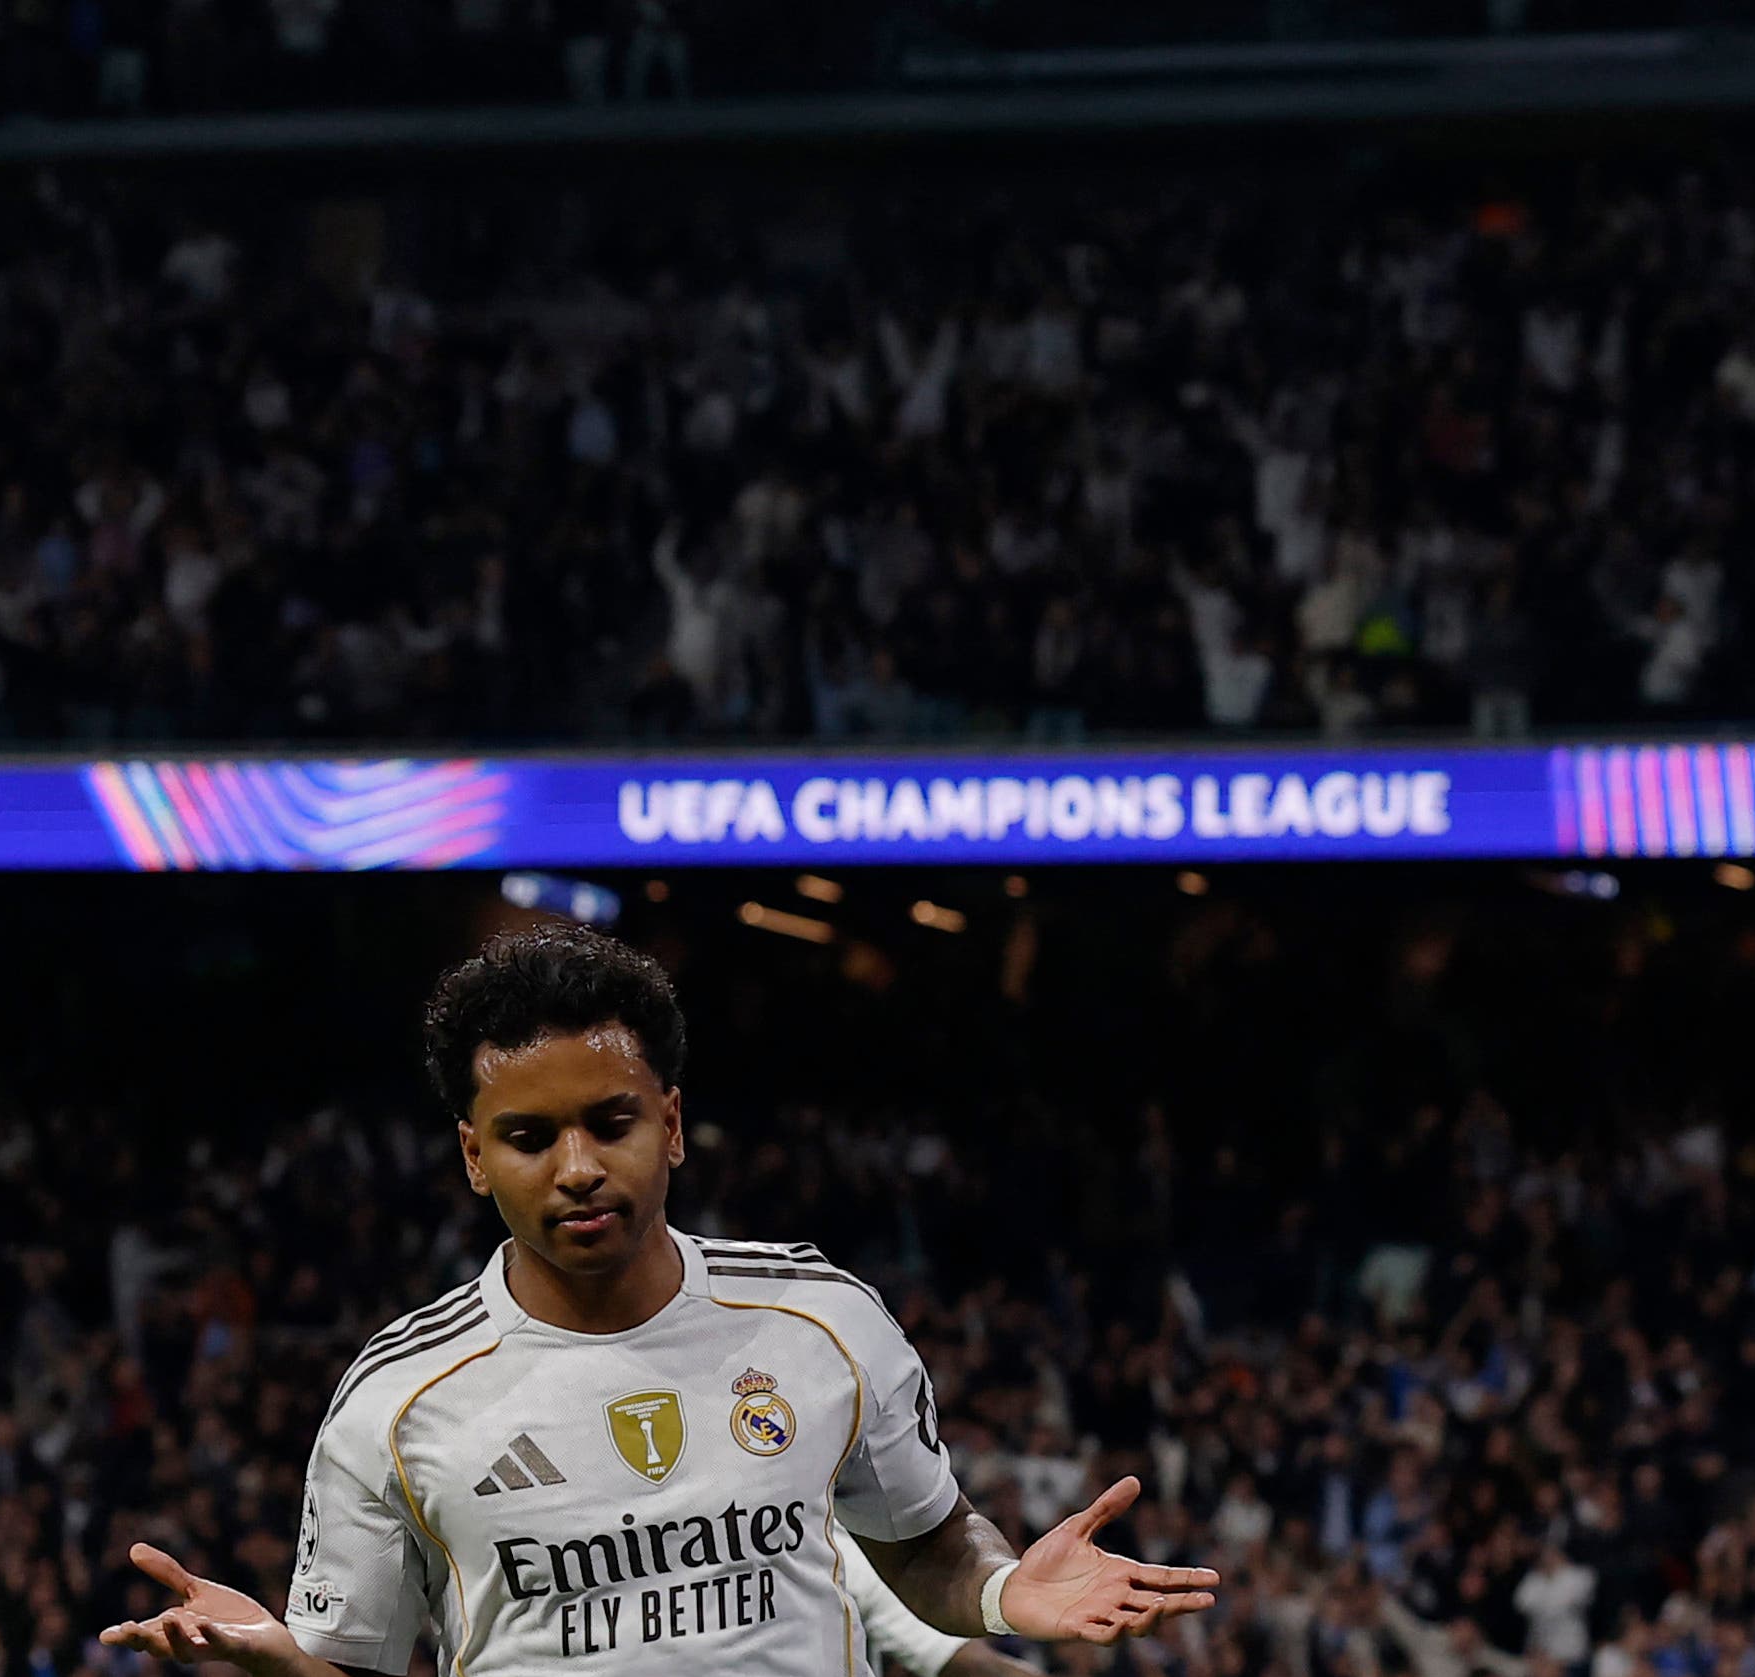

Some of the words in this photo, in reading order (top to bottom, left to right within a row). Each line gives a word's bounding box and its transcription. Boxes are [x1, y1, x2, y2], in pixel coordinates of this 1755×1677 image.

[618, 780, 786, 843] UEFA
[793, 776, 1185, 843] CHAMPIONS
[1192, 772, 1450, 839] LEAGUE
[647, 1466, 666, 1477] FIFA
[493, 1500, 805, 1600] Emirates
[304, 1591, 329, 1613] 10
[562, 1596, 621, 1657] FLY
[641, 1569, 776, 1643] BETTER
